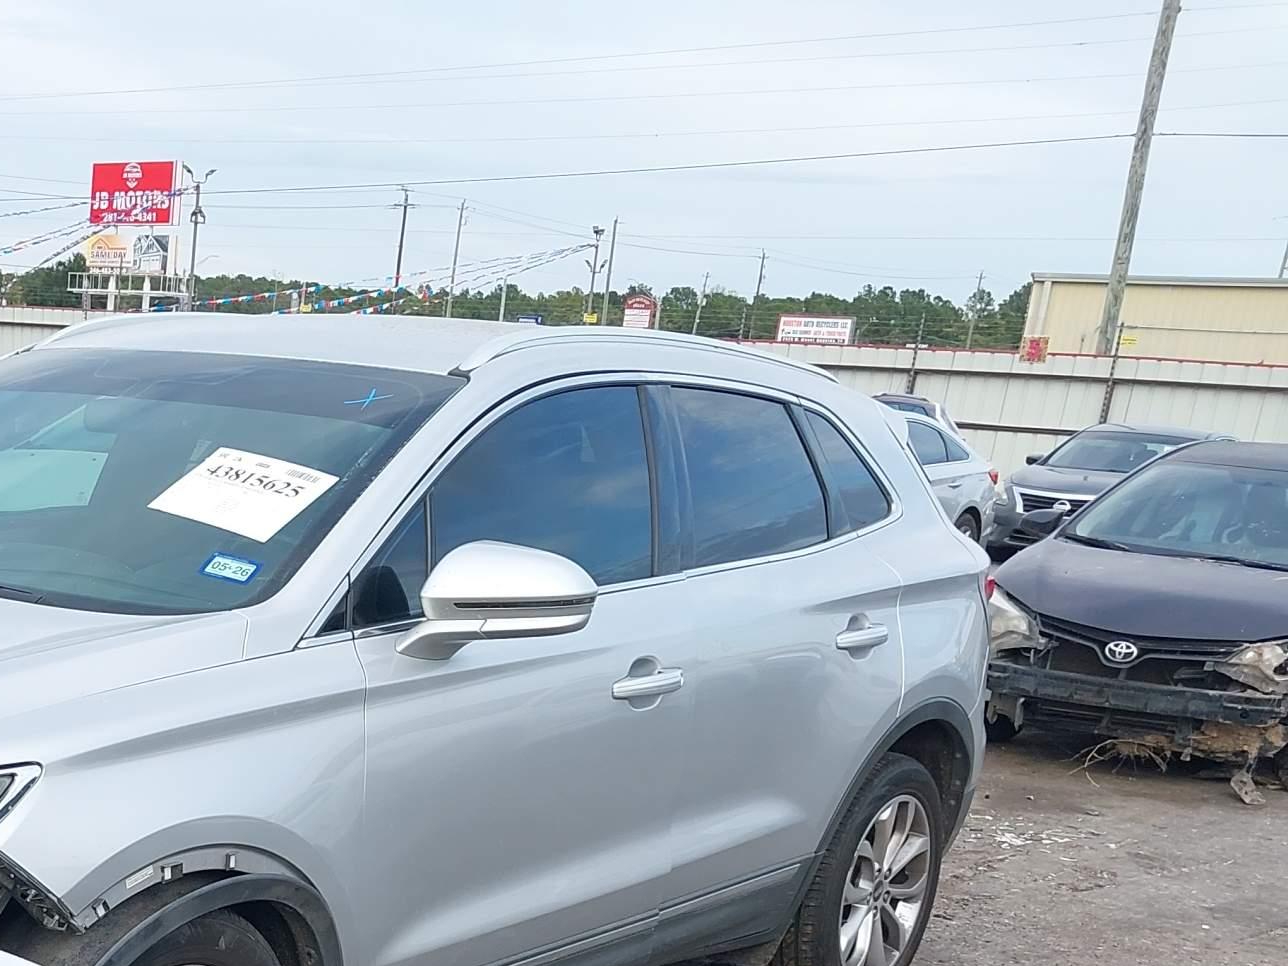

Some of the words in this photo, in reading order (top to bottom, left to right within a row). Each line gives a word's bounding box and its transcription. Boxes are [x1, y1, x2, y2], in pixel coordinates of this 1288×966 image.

[92, 191, 109, 210] JB
[113, 189, 170, 210] MOTORS
[207, 464, 306, 498] 43815625
